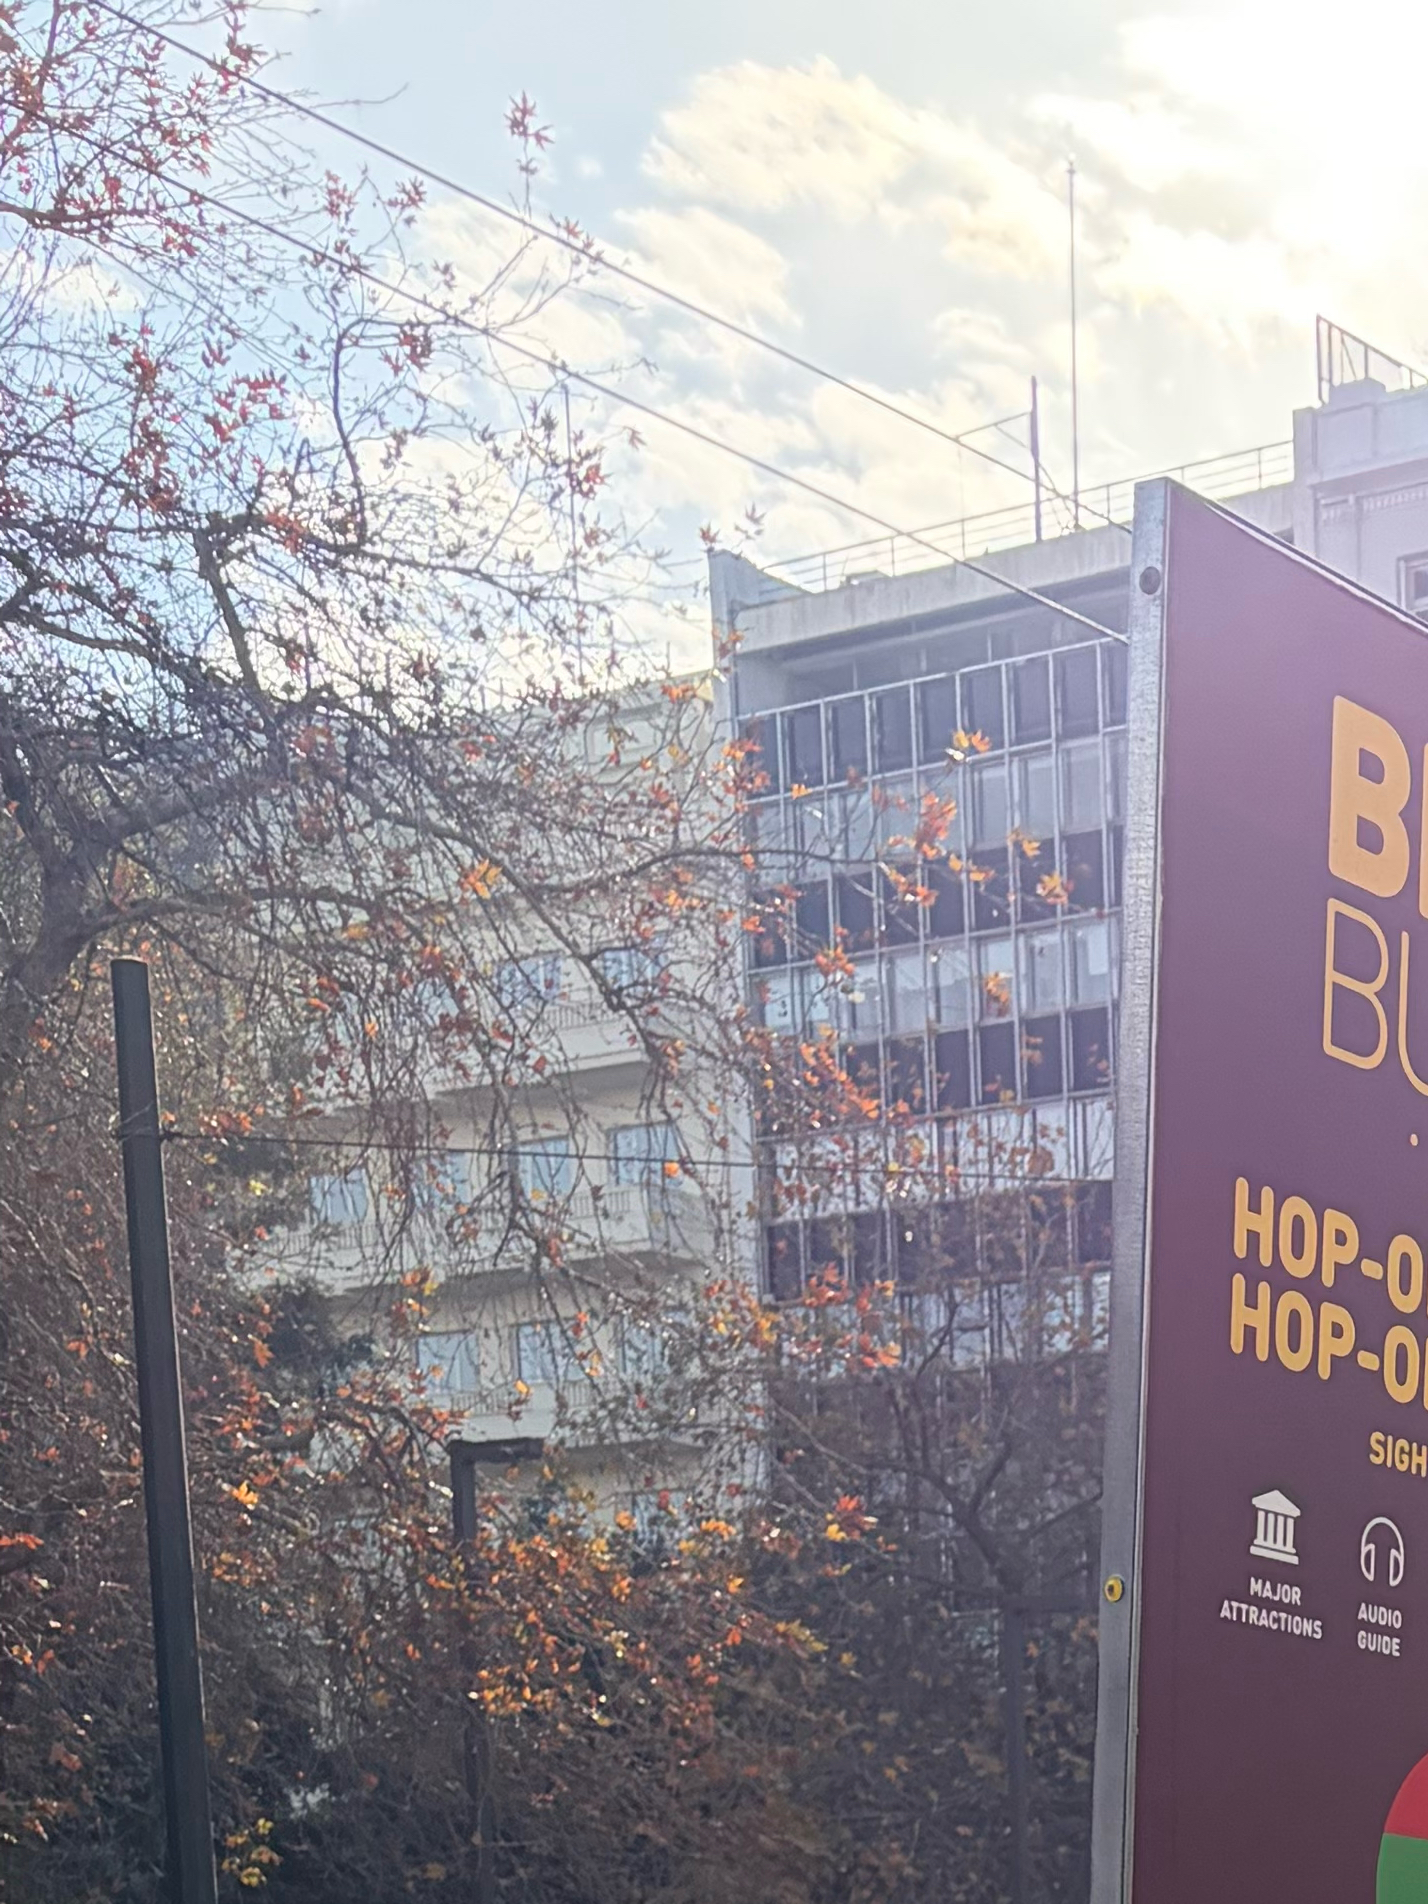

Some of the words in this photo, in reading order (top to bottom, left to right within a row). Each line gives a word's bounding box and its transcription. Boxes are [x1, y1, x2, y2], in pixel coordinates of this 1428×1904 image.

[1249, 1576, 1302, 1606] MAJOR
[1219, 1600, 1323, 1640] ATTRACTIONS
[1357, 1602, 1403, 1629] AUDIO
[1357, 1630, 1401, 1658] GUIDE
